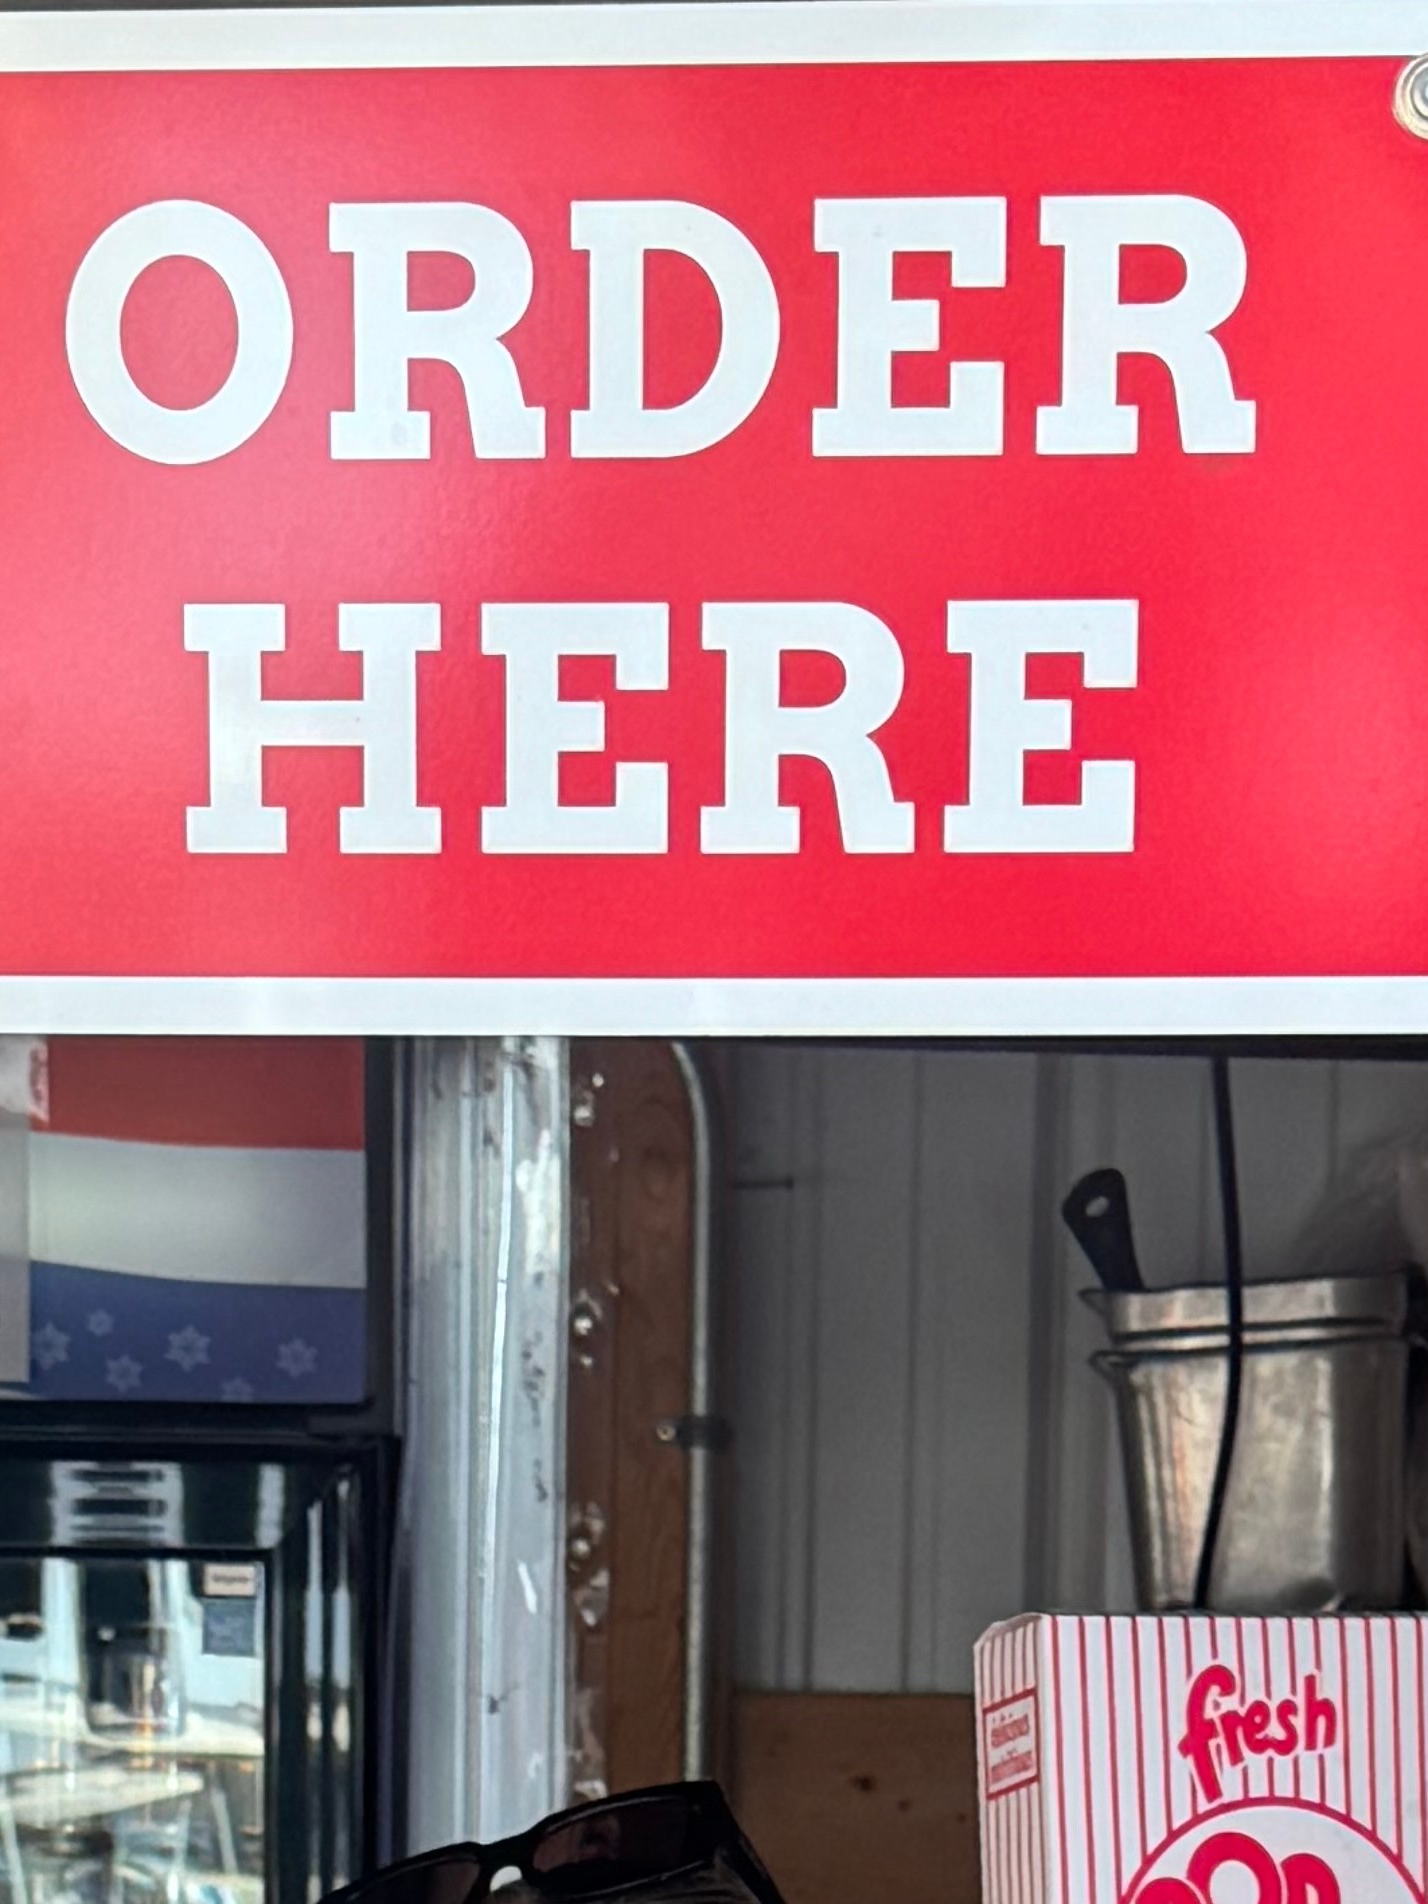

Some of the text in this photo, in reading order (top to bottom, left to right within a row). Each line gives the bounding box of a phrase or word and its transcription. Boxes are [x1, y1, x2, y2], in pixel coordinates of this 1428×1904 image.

[64, 194, 1257, 464] ORDER
[182, 598, 1139, 855] HERE
[1179, 1663, 1338, 1802] fresh
